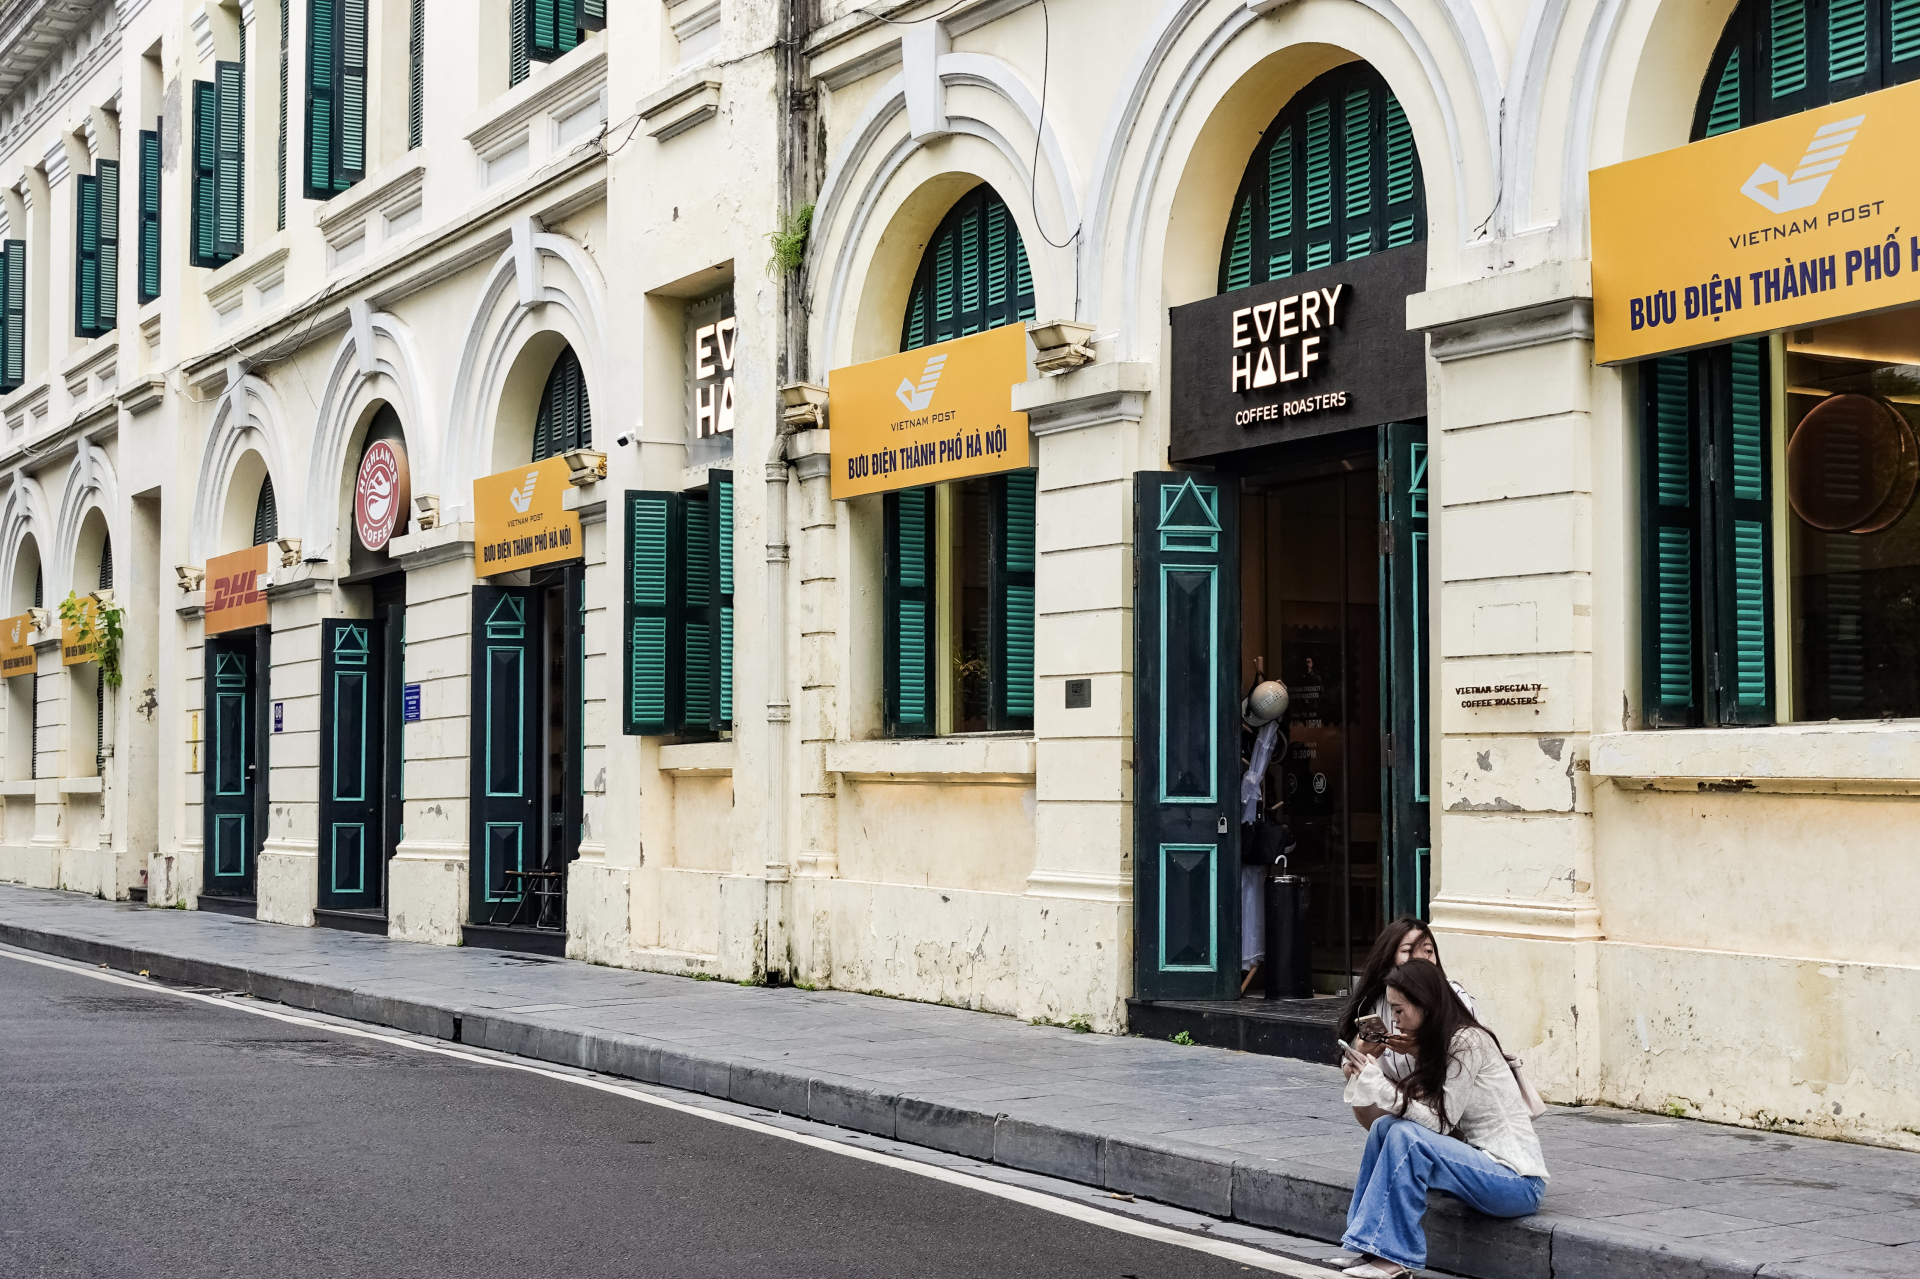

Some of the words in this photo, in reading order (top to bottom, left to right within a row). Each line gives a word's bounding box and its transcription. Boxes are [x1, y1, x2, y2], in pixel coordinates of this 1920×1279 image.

[1729, 216, 1818, 249] VIETNAM
[1827, 200, 1885, 227] POST
[1629, 289, 1677, 331] BƯU
[1684, 273, 1742, 322] ĐIỆN
[1749, 257, 1836, 306] THÀNH
[1845, 226, 1901, 286] PHỐ
[1232, 283, 1343, 349] EVERY
[1232, 336, 1320, 393] HALF
[890, 416, 929, 432] VIETNAM
[932, 410, 956, 423] POST
[1235, 404, 1279, 426] COFFEE
[1283, 391, 1347, 417] ROASTERS
[359, 447, 398, 495] HIGHLANDS
[848, 453, 869, 480] BƯU
[872, 446, 897, 478] ĐIỆN
[899, 440, 936, 470] THÀNH
[939, 428, 963, 463] PHỐ
[966, 428, 983, 458] HÀ
[985, 424, 1007, 458] NỘI
[362, 515, 393, 543] COFFEE
[507, 517, 529, 528] VIETNAM
[530, 513, 544, 522] POST
[483, 543, 496, 563] BƯU
[497, 538, 511, 562] ĐIỆN
[512, 534, 533, 557] THÀNH
[534, 526, 548, 552] PHỐ
[548, 526, 558, 549] HÀ
[559, 524, 571, 550] NỘI
[213, 569, 258, 611] DHL
[1455, 686, 1492, 695] VIETNAM
[1494, 683, 1542, 693] SPECIALTY
[1461, 699, 1493, 708] COFFEE
[1495, 697, 1538, 706] ROASTERS
[1293, 749, 1317, 759] 9:30PM
